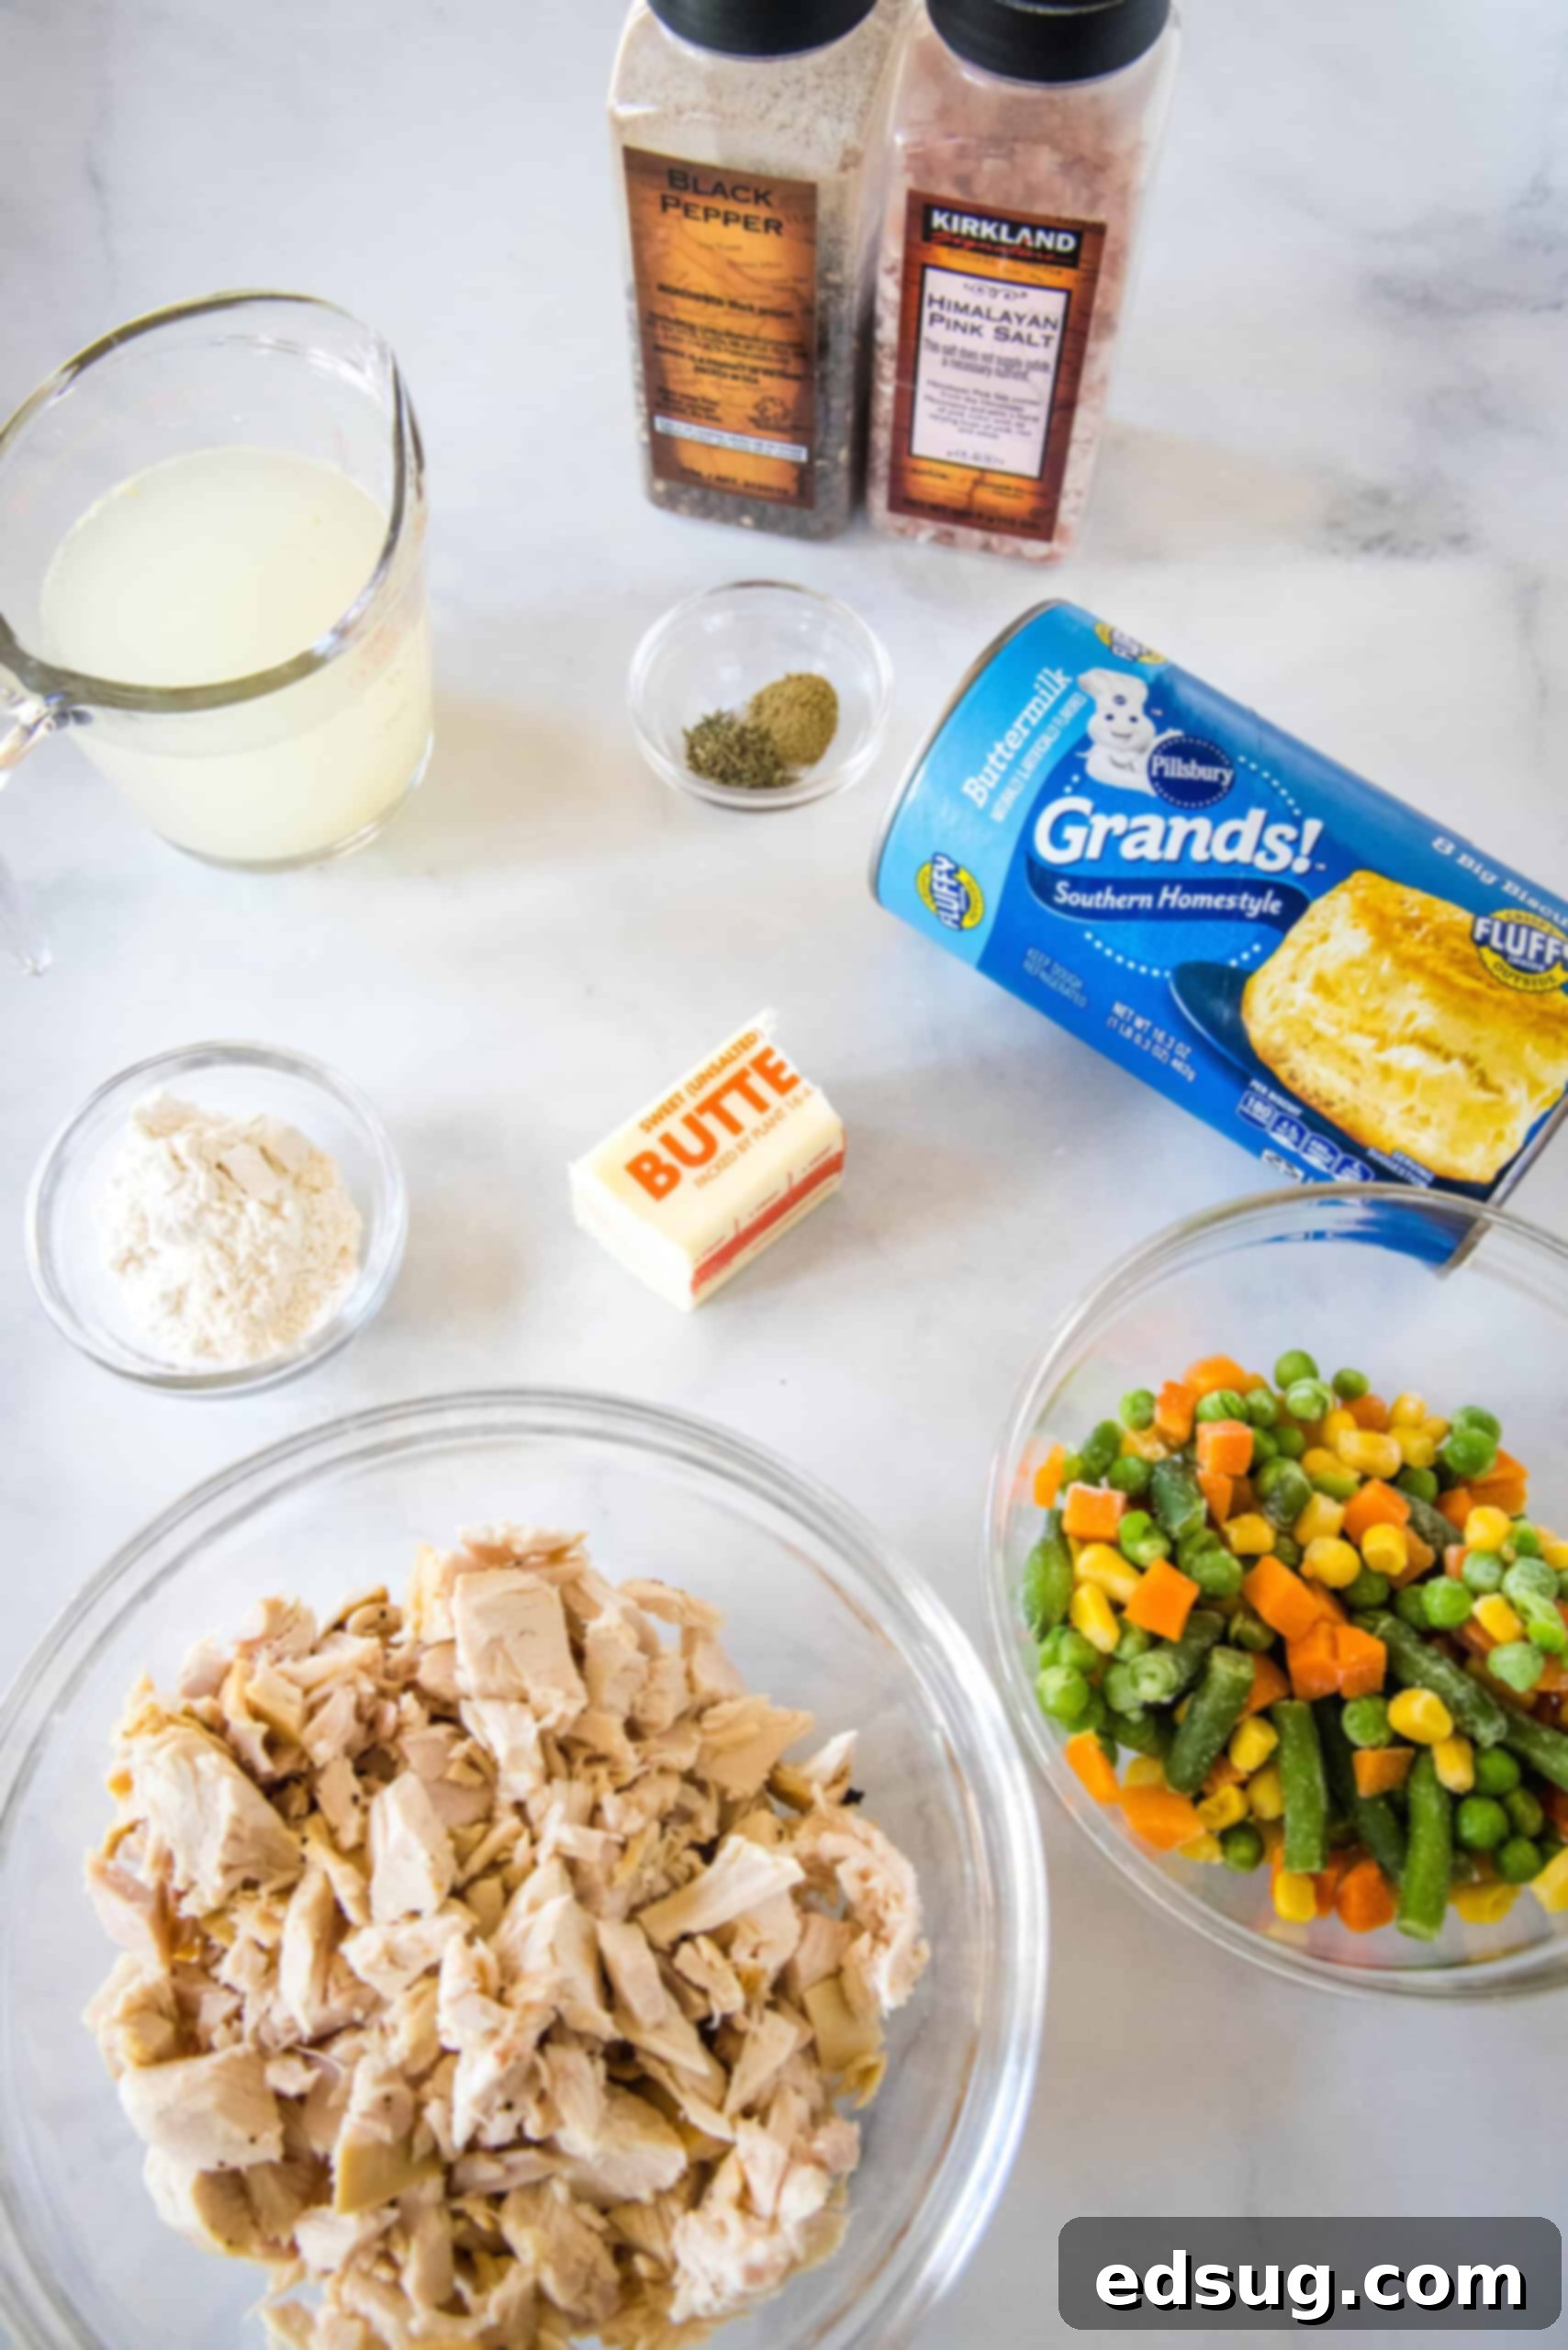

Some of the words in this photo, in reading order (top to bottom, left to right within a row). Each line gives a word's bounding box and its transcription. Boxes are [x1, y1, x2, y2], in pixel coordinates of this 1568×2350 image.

[667, 167, 774, 208] BLACK
[660, 193, 784, 236] PEPPER
[931, 207, 1077, 254] KIRKLAND
[927, 293, 1058, 330] HIMALAYAN
[928, 311, 984, 338] PINK
[993, 326, 1054, 348] SALT
[961, 666, 1072, 809] Buttermilk
[1151, 755, 1233, 787] Pillsbury
[1034, 796, 1323, 875] Grands!
[1432, 836, 1455, 856] 8
[1457, 853, 1498, 886] Big
[932, 854, 961, 930] FLUFFY
[1054, 880, 1153, 909] Southern
[1157, 884, 1282, 918] Homestyle
[625, 1046, 801, 1202] BUTTE
